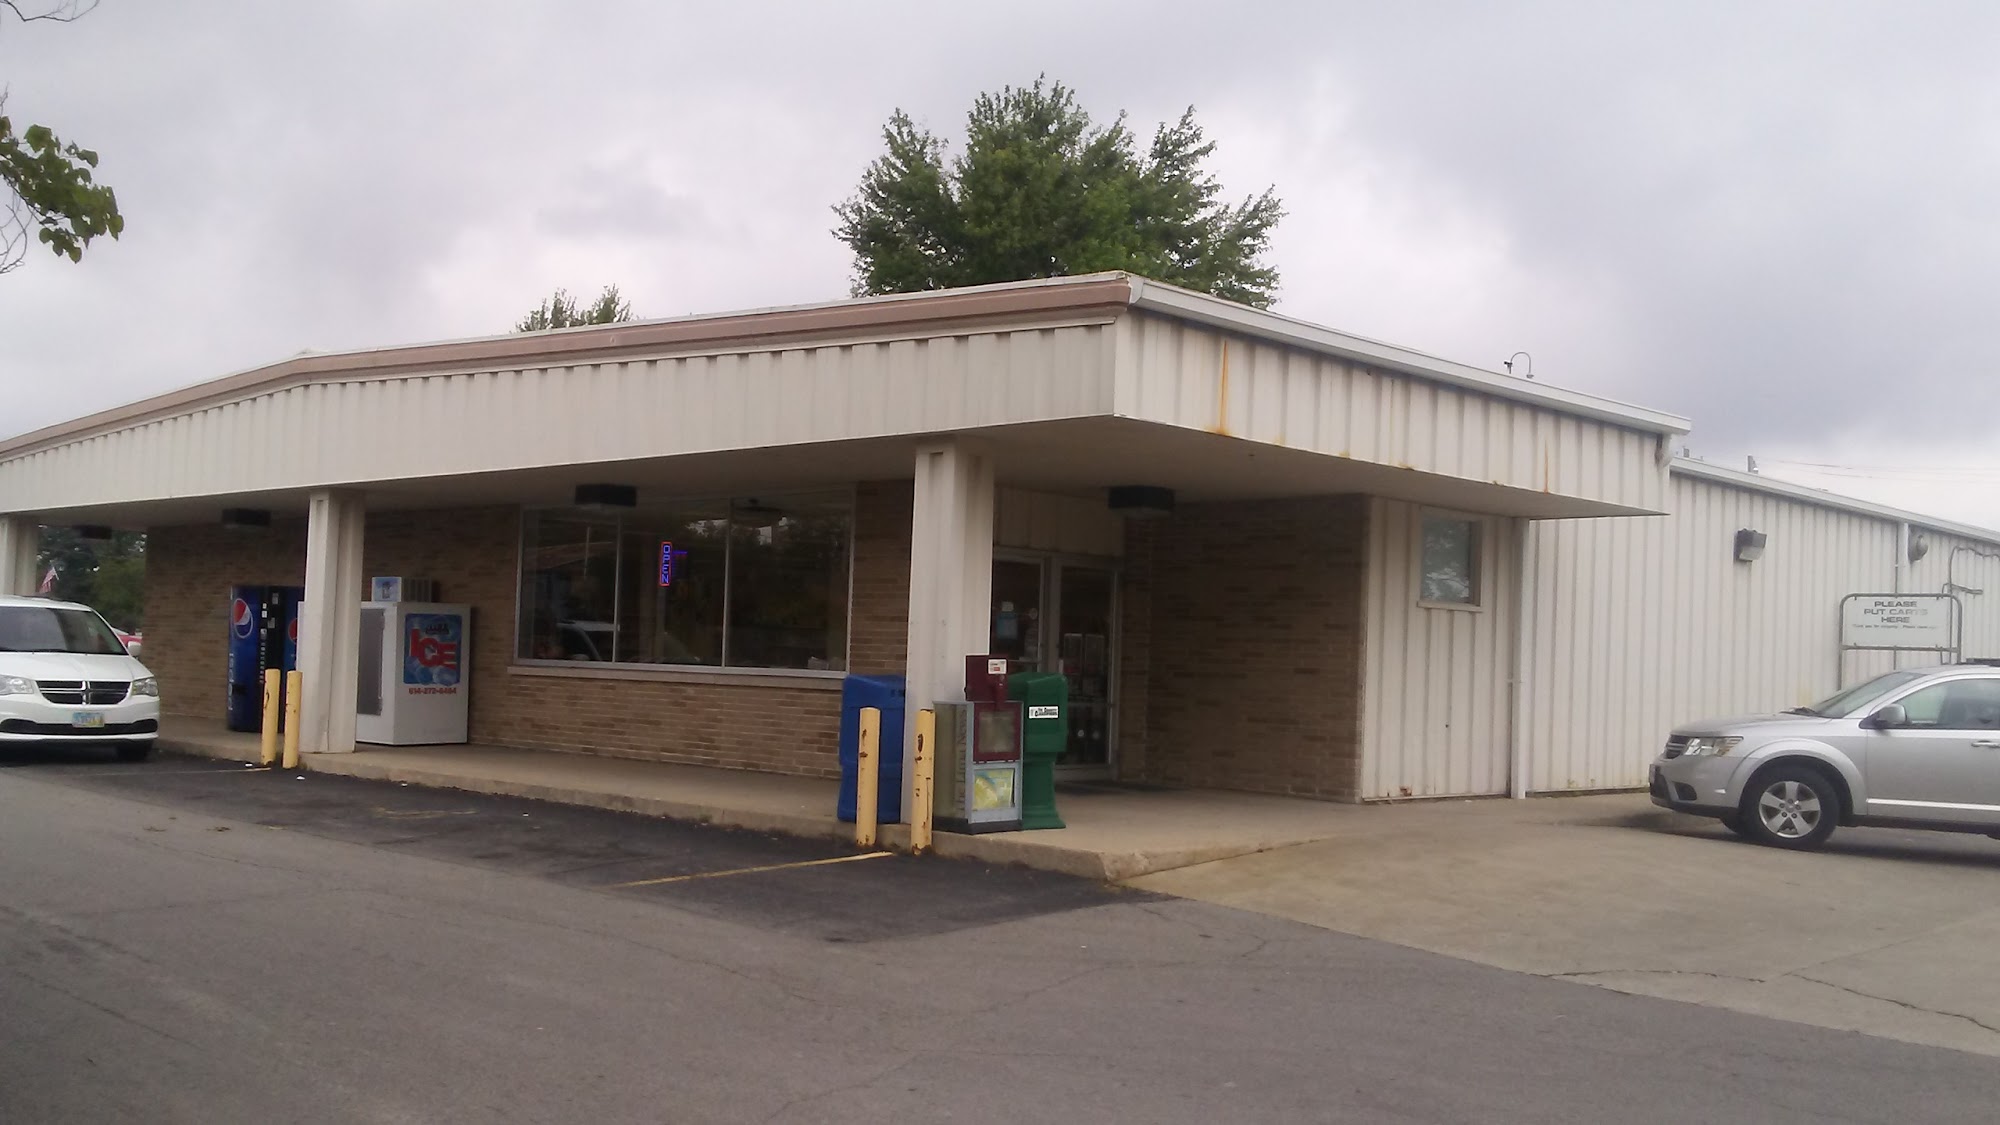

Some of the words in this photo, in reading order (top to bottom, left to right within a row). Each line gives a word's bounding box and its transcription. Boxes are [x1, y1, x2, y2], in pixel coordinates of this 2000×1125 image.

[661, 544, 671, 584] OPEN
[1888, 608, 1929, 616] CARTS
[410, 628, 458, 670] ICE
